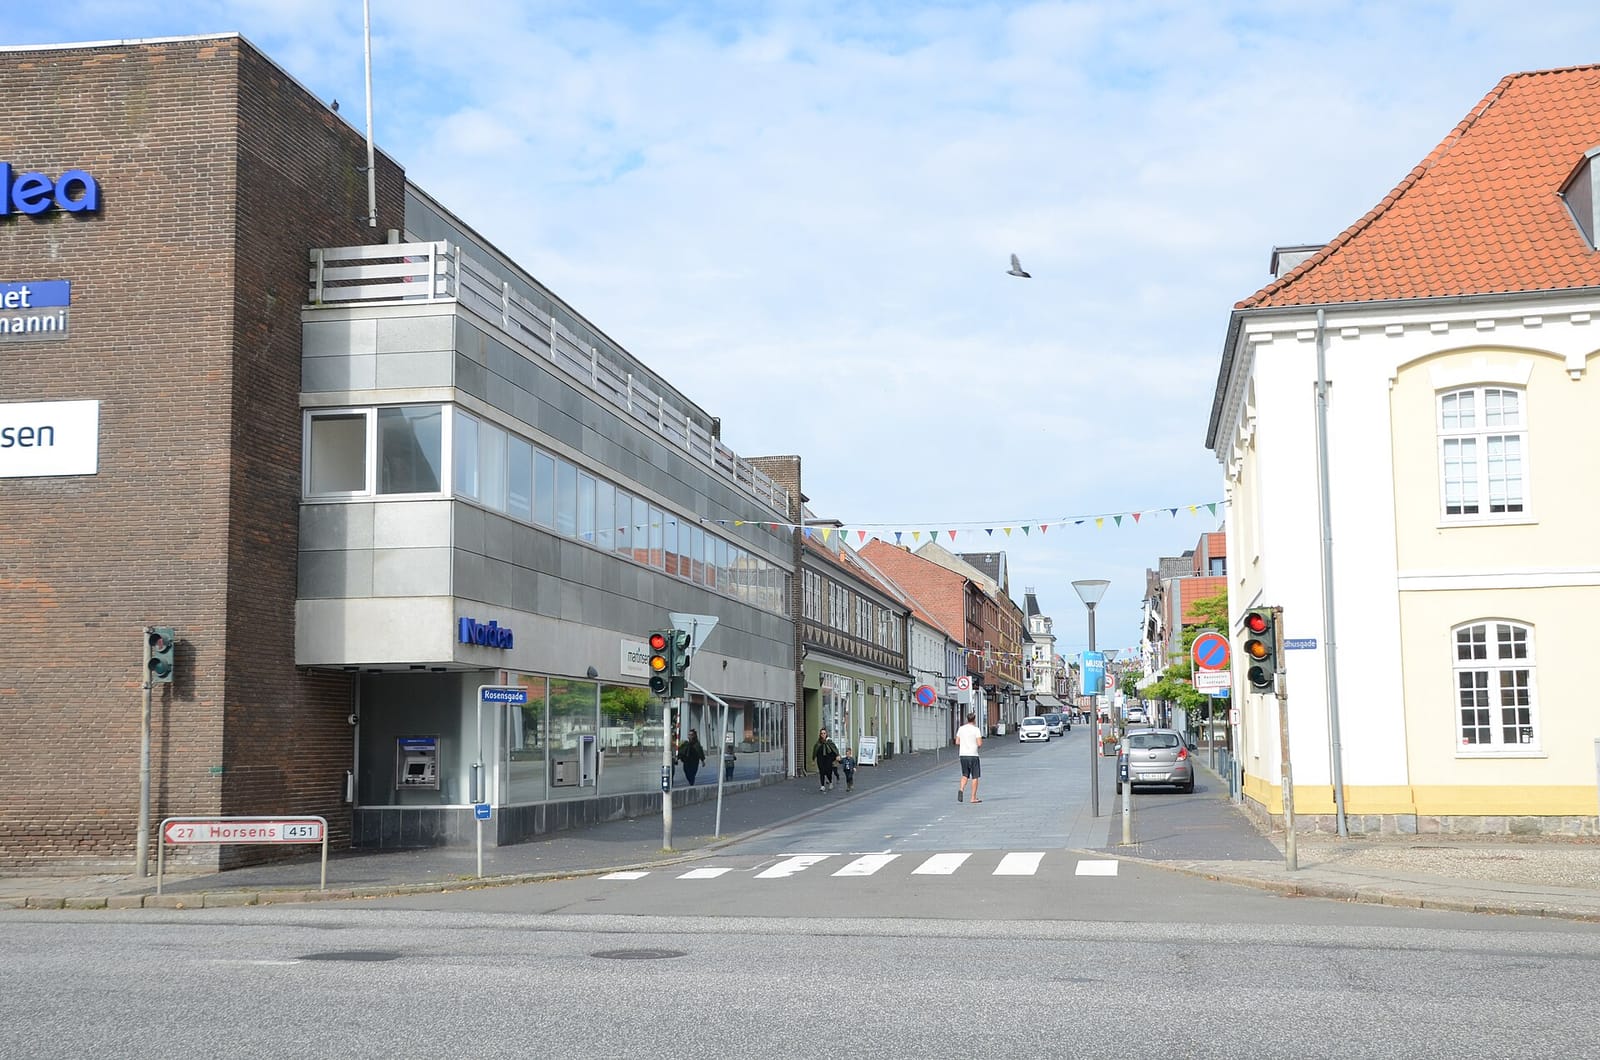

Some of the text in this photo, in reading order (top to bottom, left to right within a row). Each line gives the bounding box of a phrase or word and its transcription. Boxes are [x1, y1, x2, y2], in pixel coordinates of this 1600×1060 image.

[1, 425, 54, 448] sen
[458, 617, 513, 649] Nordea
[484, 690, 523, 702] Rosensgade
[177, 826, 313, 838] 27 Horsens 451
